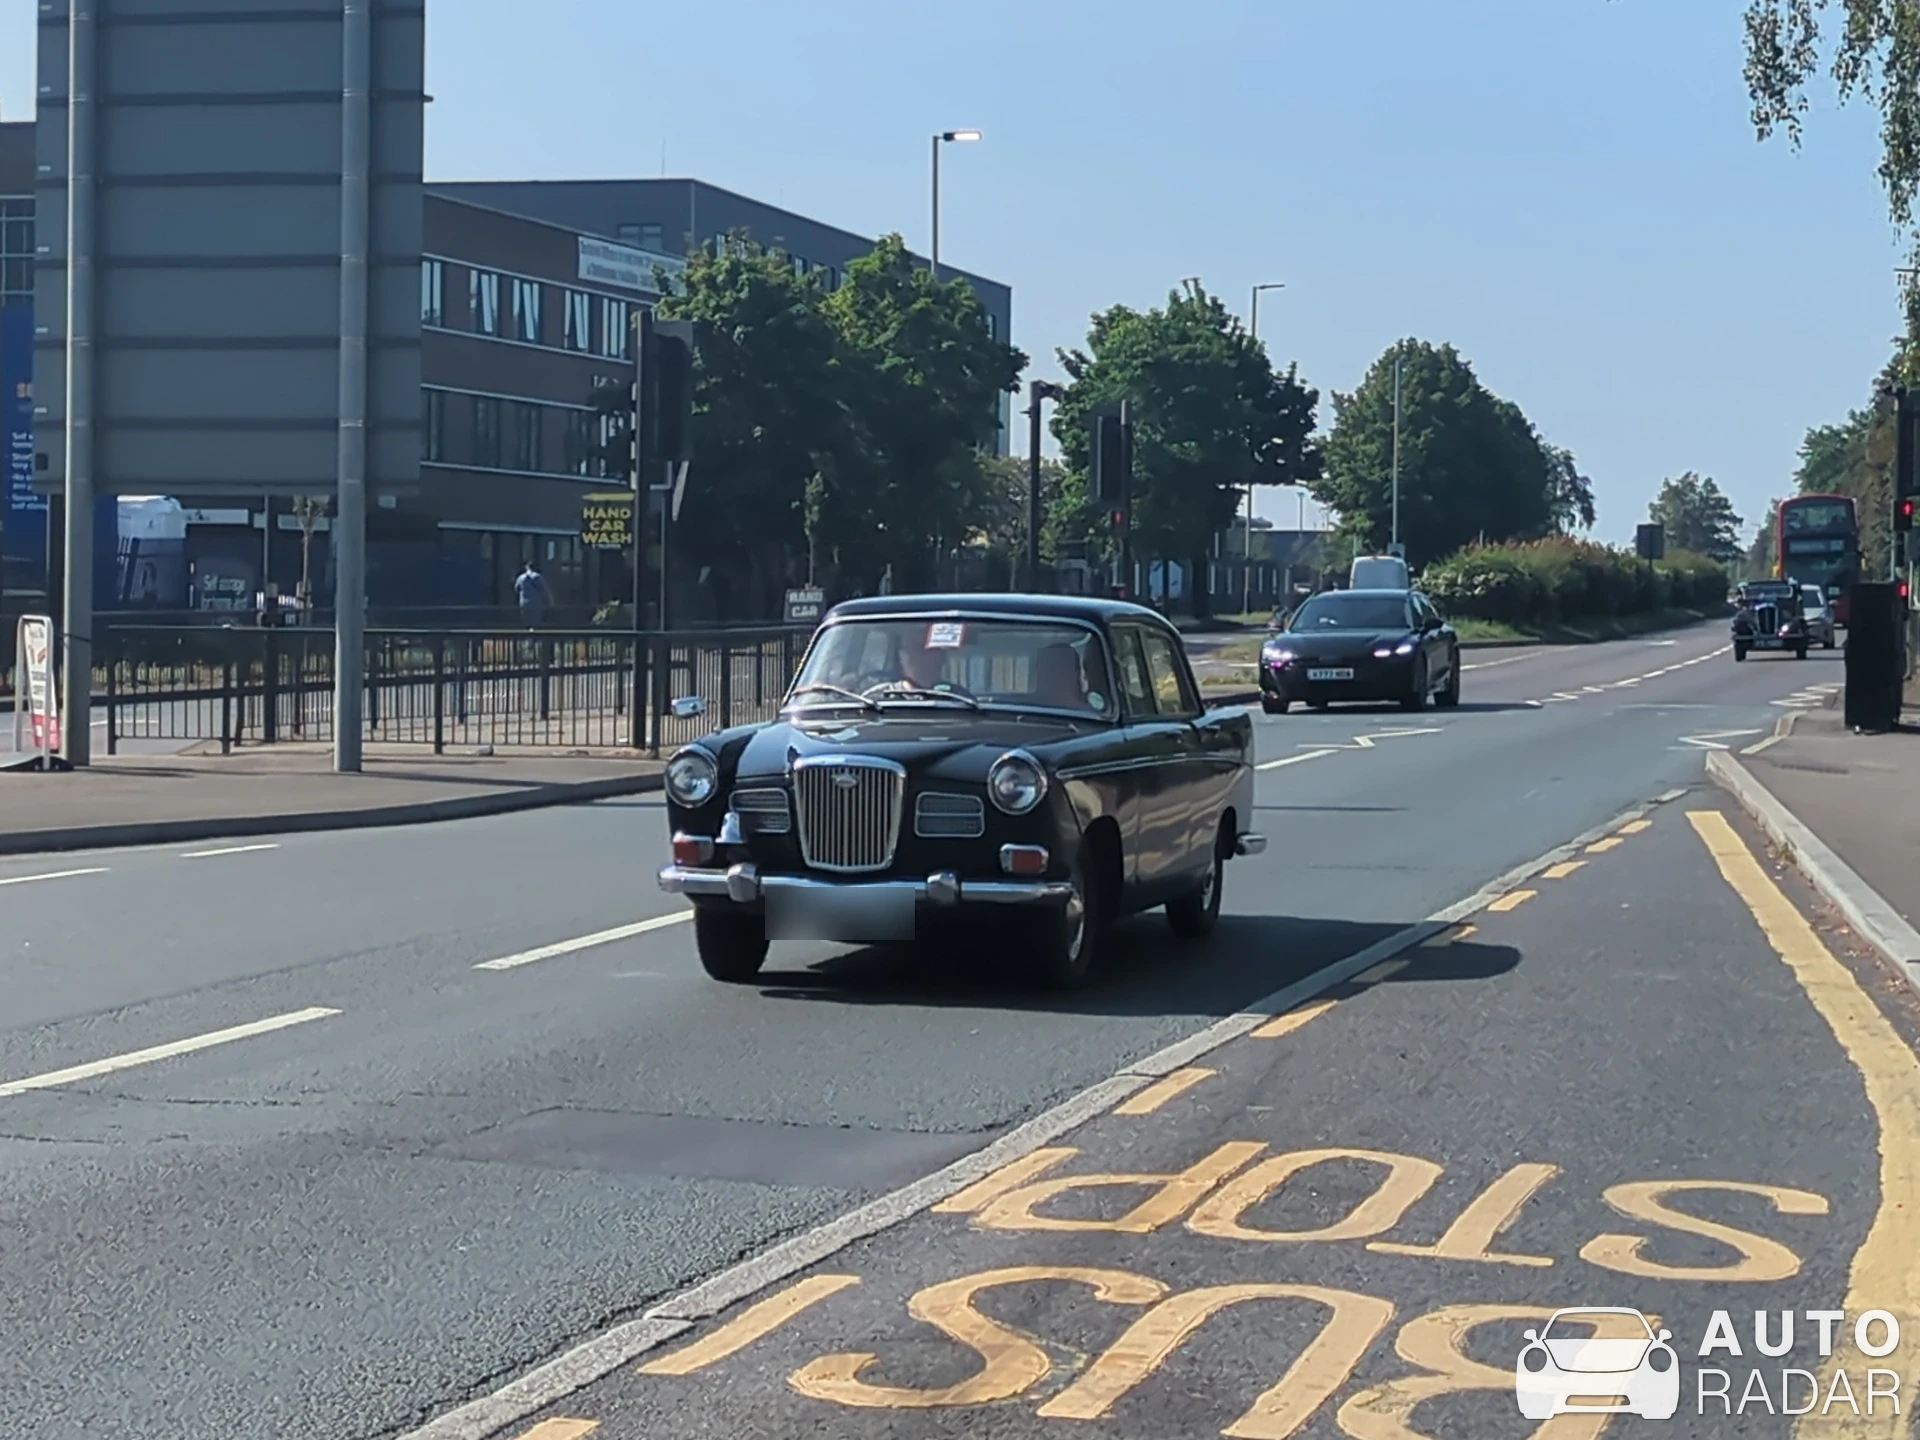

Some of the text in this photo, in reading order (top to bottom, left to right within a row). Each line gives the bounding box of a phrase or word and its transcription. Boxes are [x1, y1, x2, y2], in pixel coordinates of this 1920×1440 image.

[583, 507, 632, 519] HAND
[589, 520, 625, 531] CAR
[582, 532, 632, 544] WASH
[791, 605, 818, 617] CAR
[970, 1141, 1830, 1282] STOP
[787, 1265, 1662, 1440] BUS
